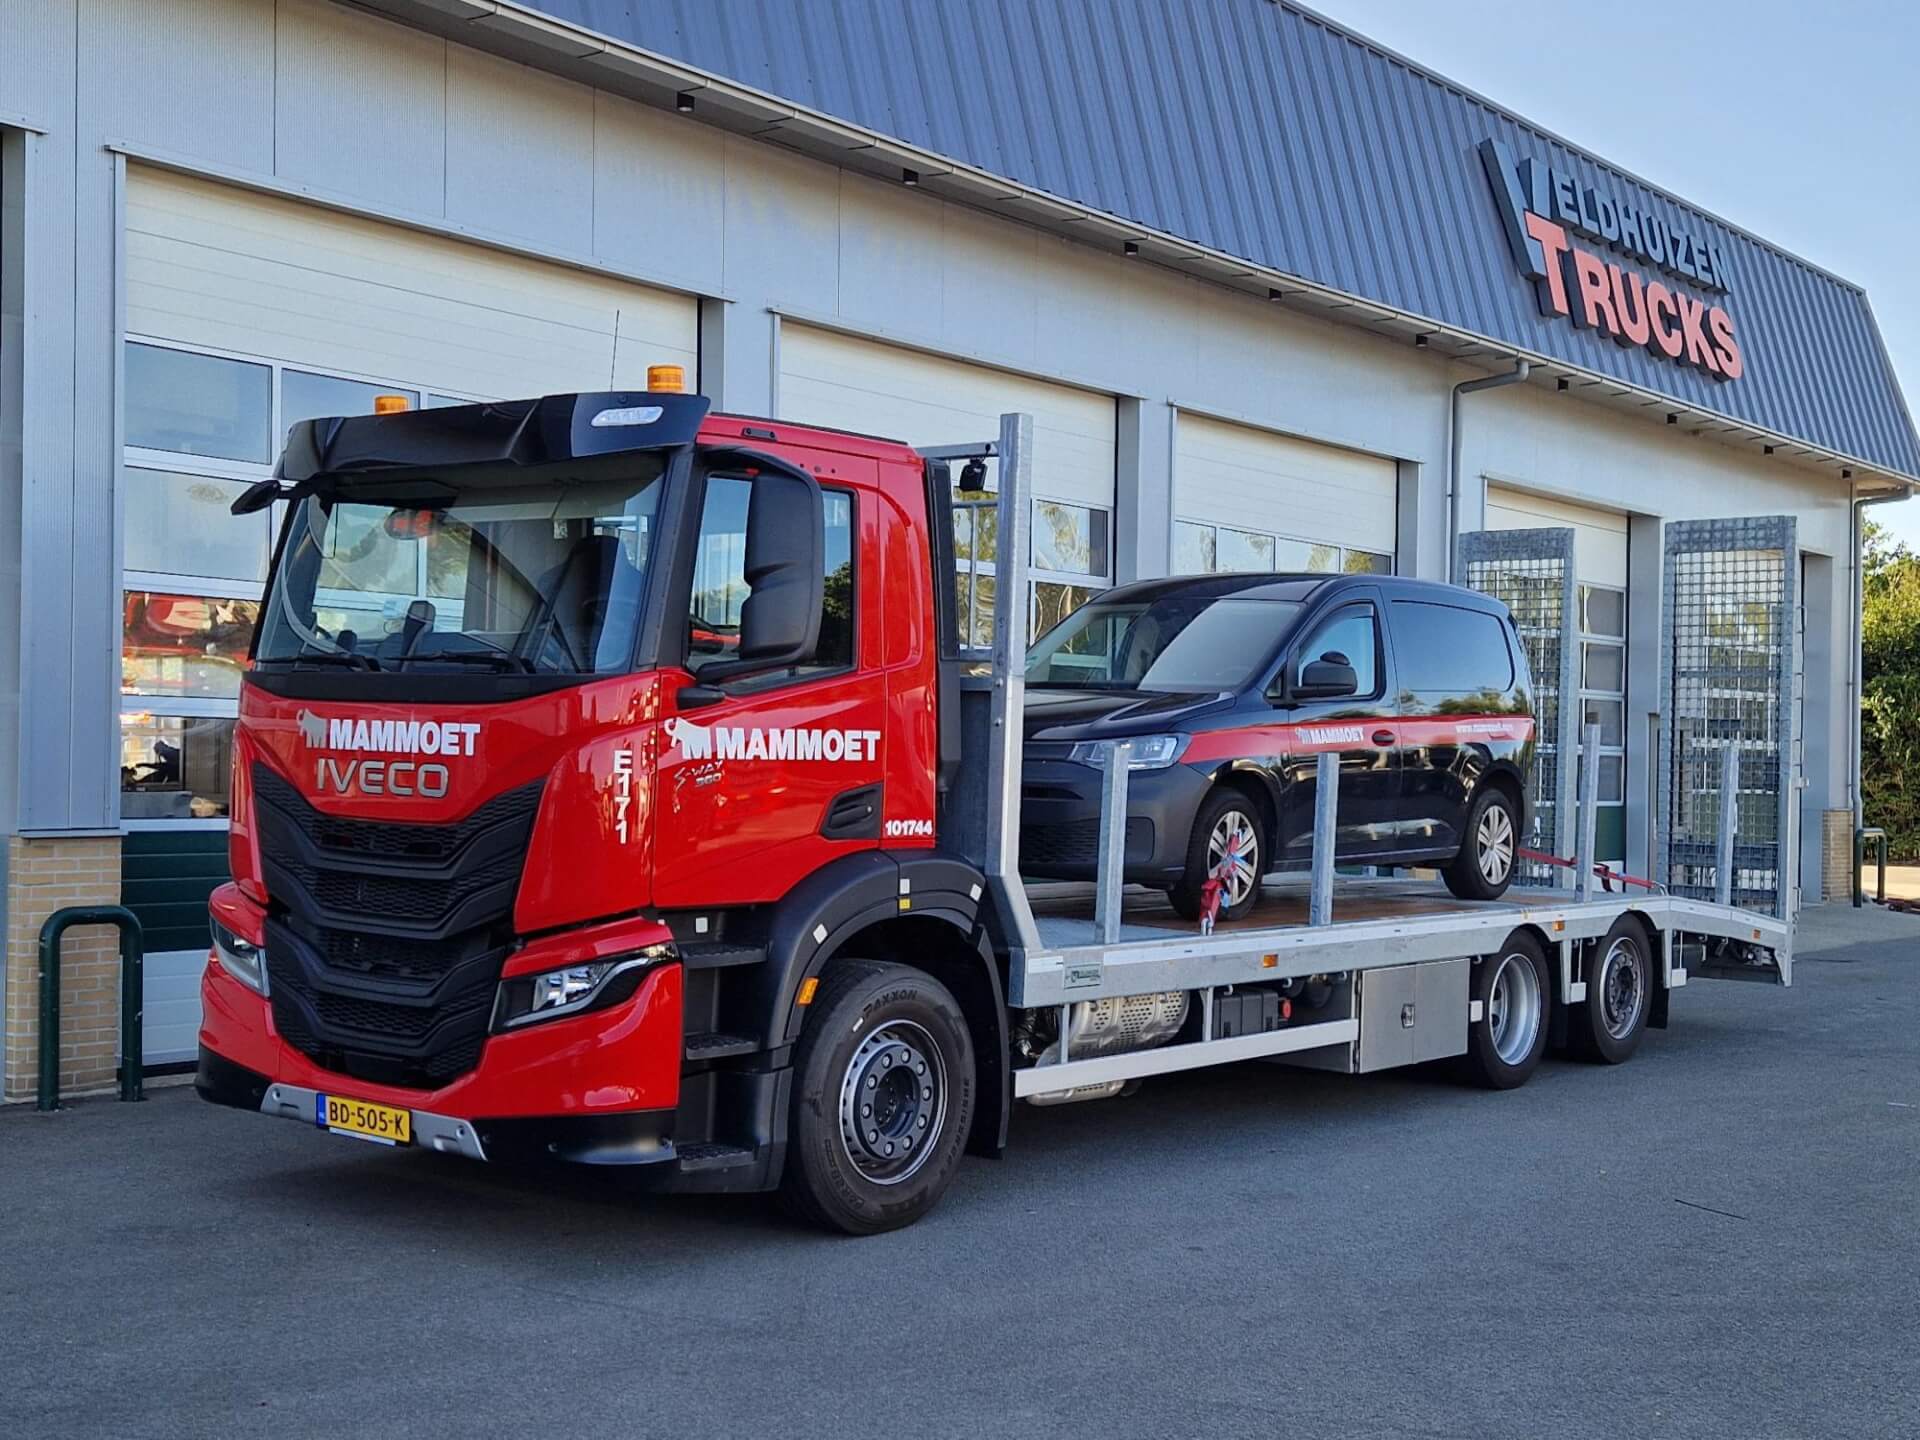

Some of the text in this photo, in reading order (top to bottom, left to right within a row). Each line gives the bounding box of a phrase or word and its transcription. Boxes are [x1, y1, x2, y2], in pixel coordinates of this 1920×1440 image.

[1482, 138, 1729, 292] VELDHUIZEN
[1525, 211, 1743, 379] TRUCKS
[330, 719, 481, 756] MAMMOET
[716, 727, 881, 761] MAMMOET
[1310, 727, 1364, 744] MAMMOET
[317, 758, 449, 797] IVECO
[613, 750, 633, 844] E171
[885, 820, 932, 836] 101744
[329, 1101, 404, 1137] BD-505-K
